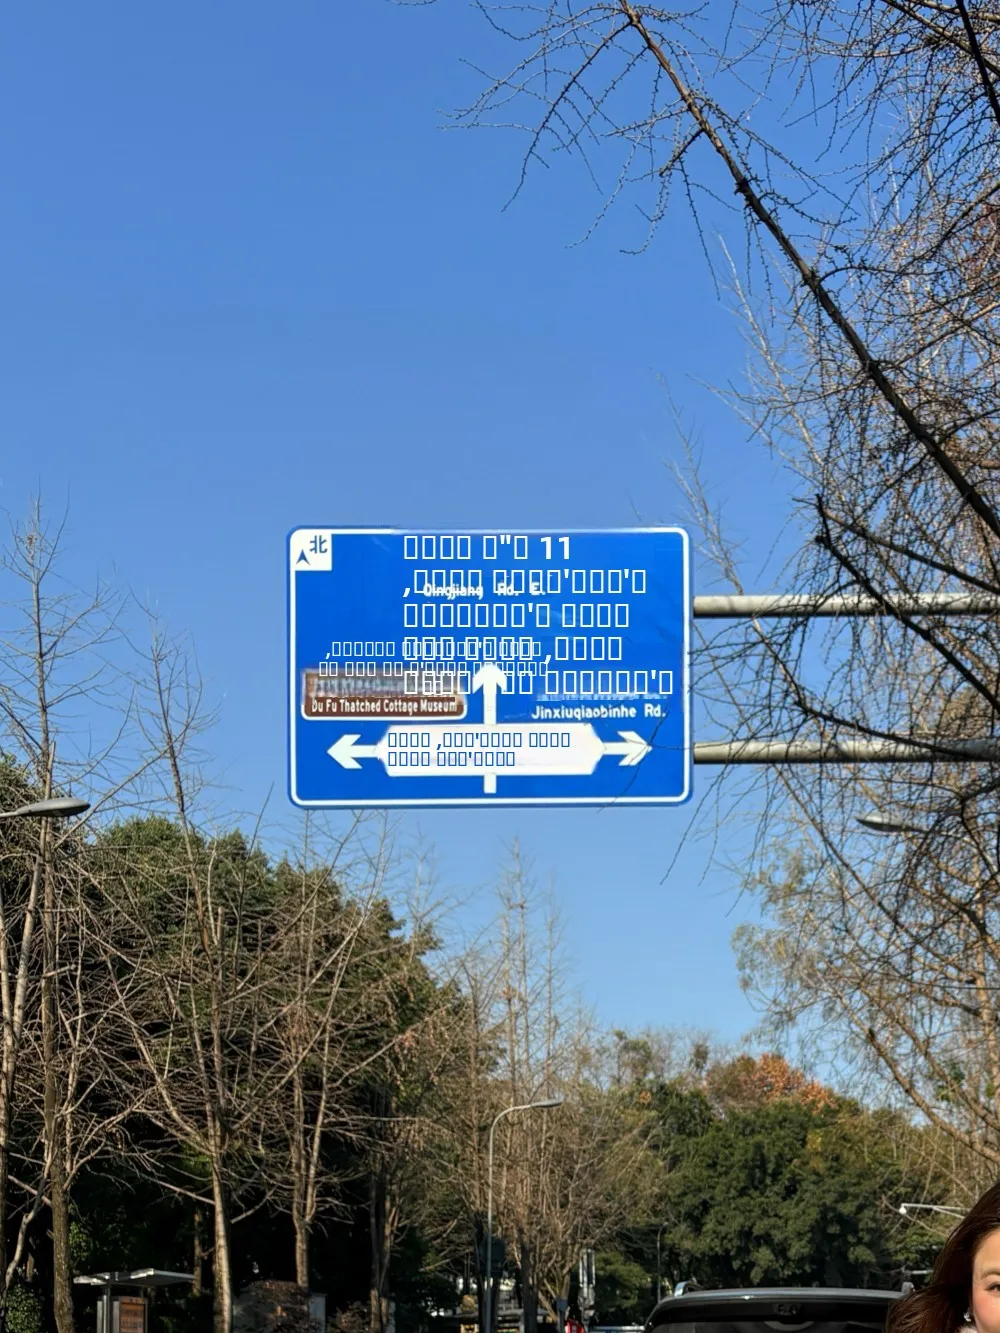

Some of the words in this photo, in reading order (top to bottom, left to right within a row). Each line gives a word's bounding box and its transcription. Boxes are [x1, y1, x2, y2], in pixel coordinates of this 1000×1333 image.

[309, 534, 328, 554] 北
[312, 699, 324, 712] Du
[325, 699, 338, 712] Fu
[339, 699, 381, 713] Thatched
[383, 699, 418, 715] Cottage
[420, 699, 458, 713] Museum
[531, 704, 637, 720] Jinxiuqiaobinhe
[644, 703, 667, 717] Rd.
